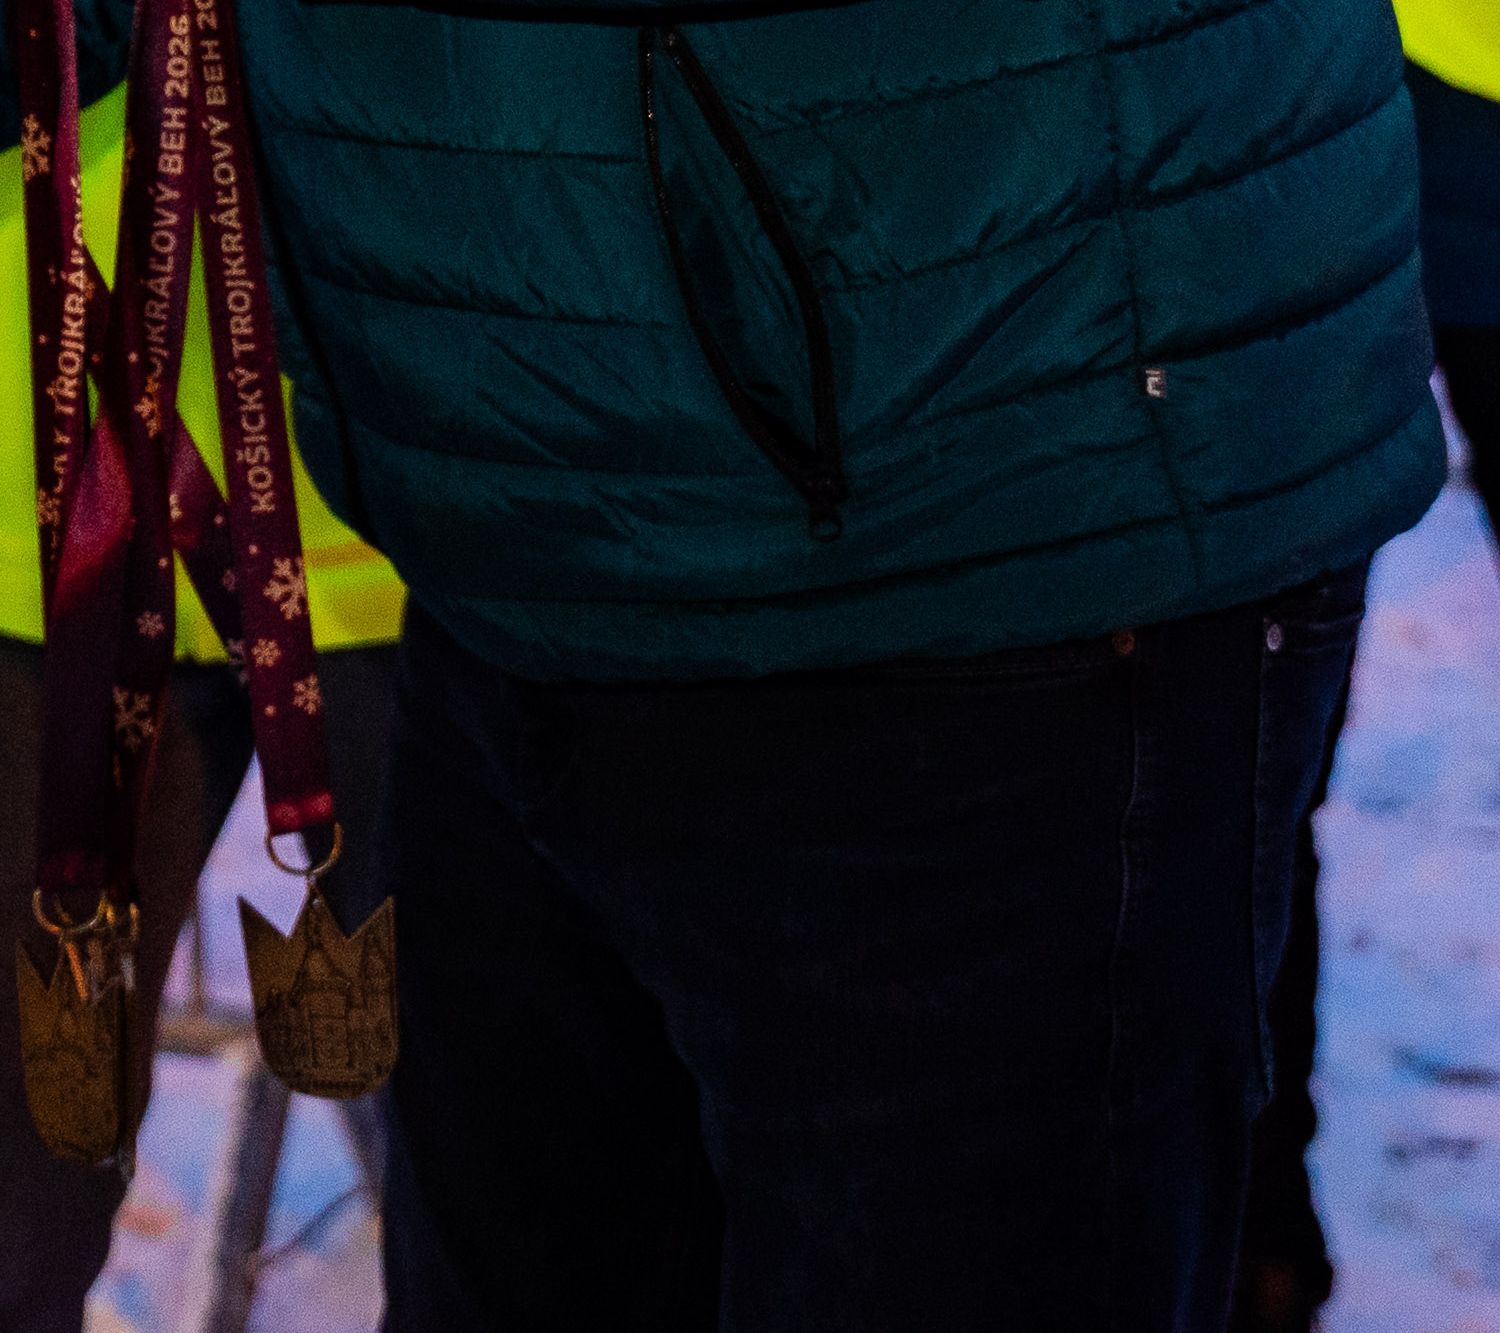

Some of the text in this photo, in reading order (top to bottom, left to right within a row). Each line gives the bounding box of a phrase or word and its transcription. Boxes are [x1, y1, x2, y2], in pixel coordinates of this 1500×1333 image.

[164, 14, 192, 99] 2026
[201, 38, 228, 106] BEH
[157, 106, 187, 176] BEH
[201, 115, 256, 359] TROJKRÁĽOVÝ
[227, 365, 276, 514] KOŠICKÝ
